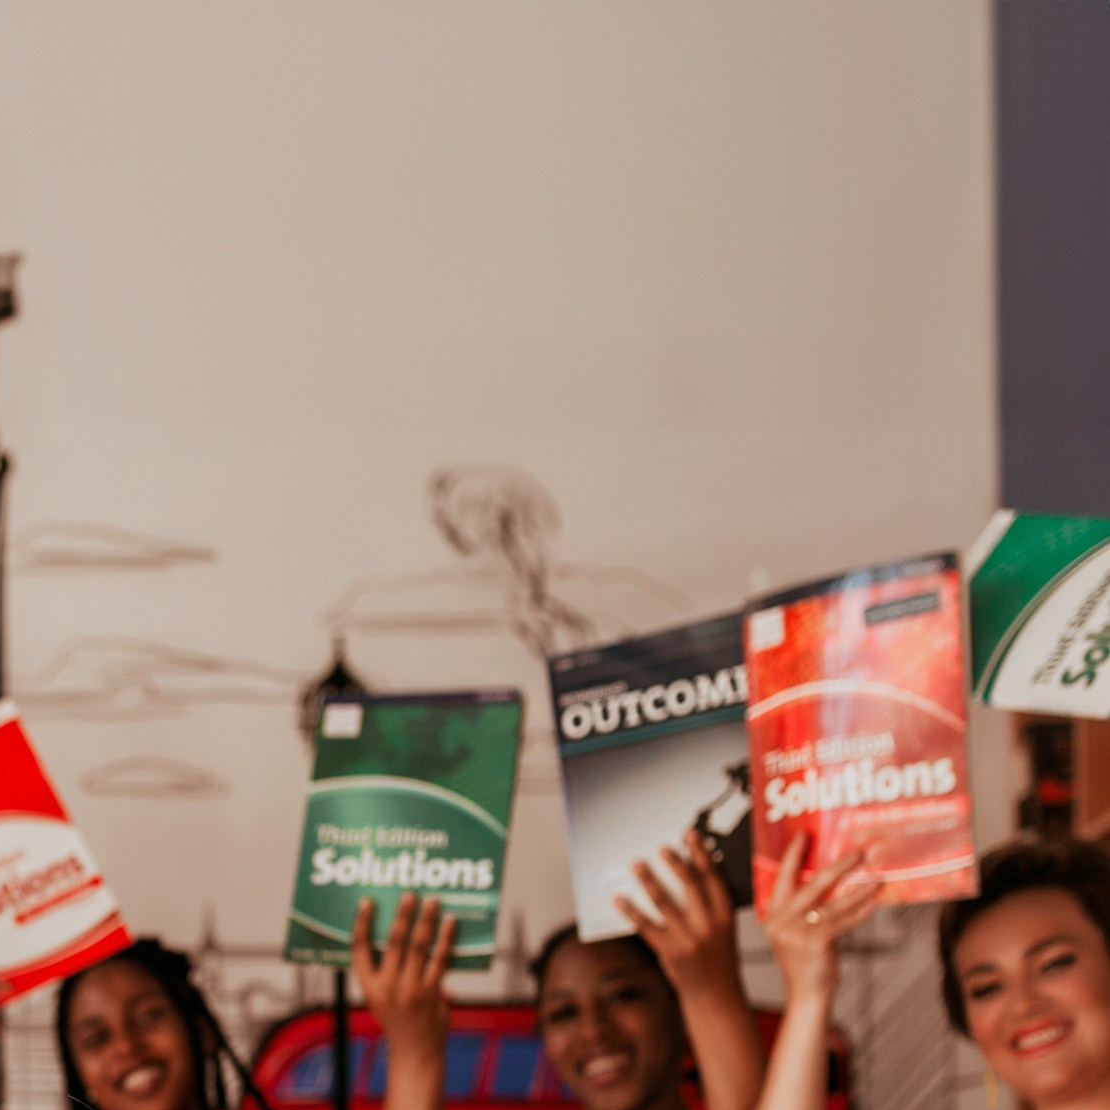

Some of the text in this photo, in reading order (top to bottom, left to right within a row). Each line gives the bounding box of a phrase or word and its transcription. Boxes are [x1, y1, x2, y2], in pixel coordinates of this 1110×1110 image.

[1061, 622, 1110, 688] Sol
[765, 756, 957, 823] Solutions
[310, 846, 495, 890] Solutions
